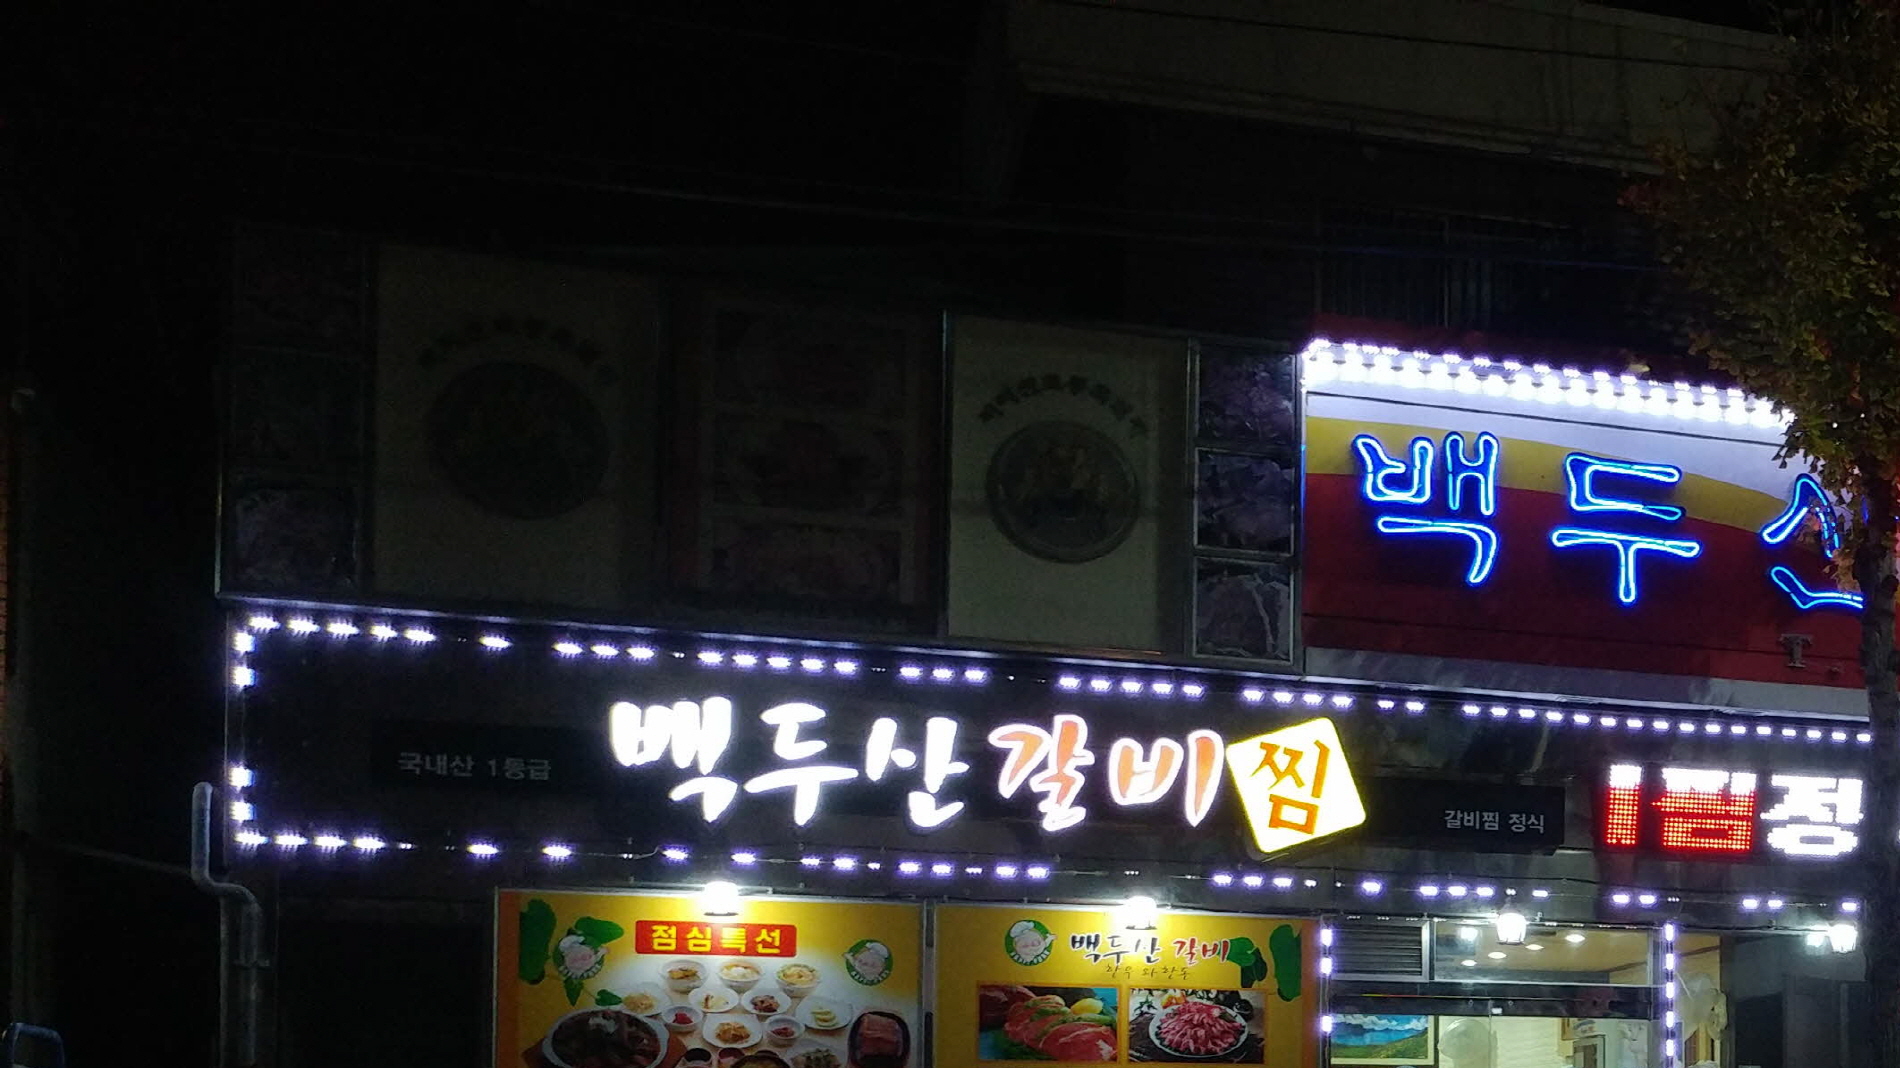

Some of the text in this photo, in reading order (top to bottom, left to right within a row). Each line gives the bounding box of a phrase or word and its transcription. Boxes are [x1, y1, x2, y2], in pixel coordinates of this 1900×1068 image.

[396, 750, 552, 782] 국내산 1등급
[610, 697, 968, 833] 백두산
[1445, 808, 1545, 834] 갈비찜 정식
[651, 924, 782, 954] 점심특선
[1070, 932, 1162, 967] 백두산
[1173, 937, 1231, 966] 갈비
